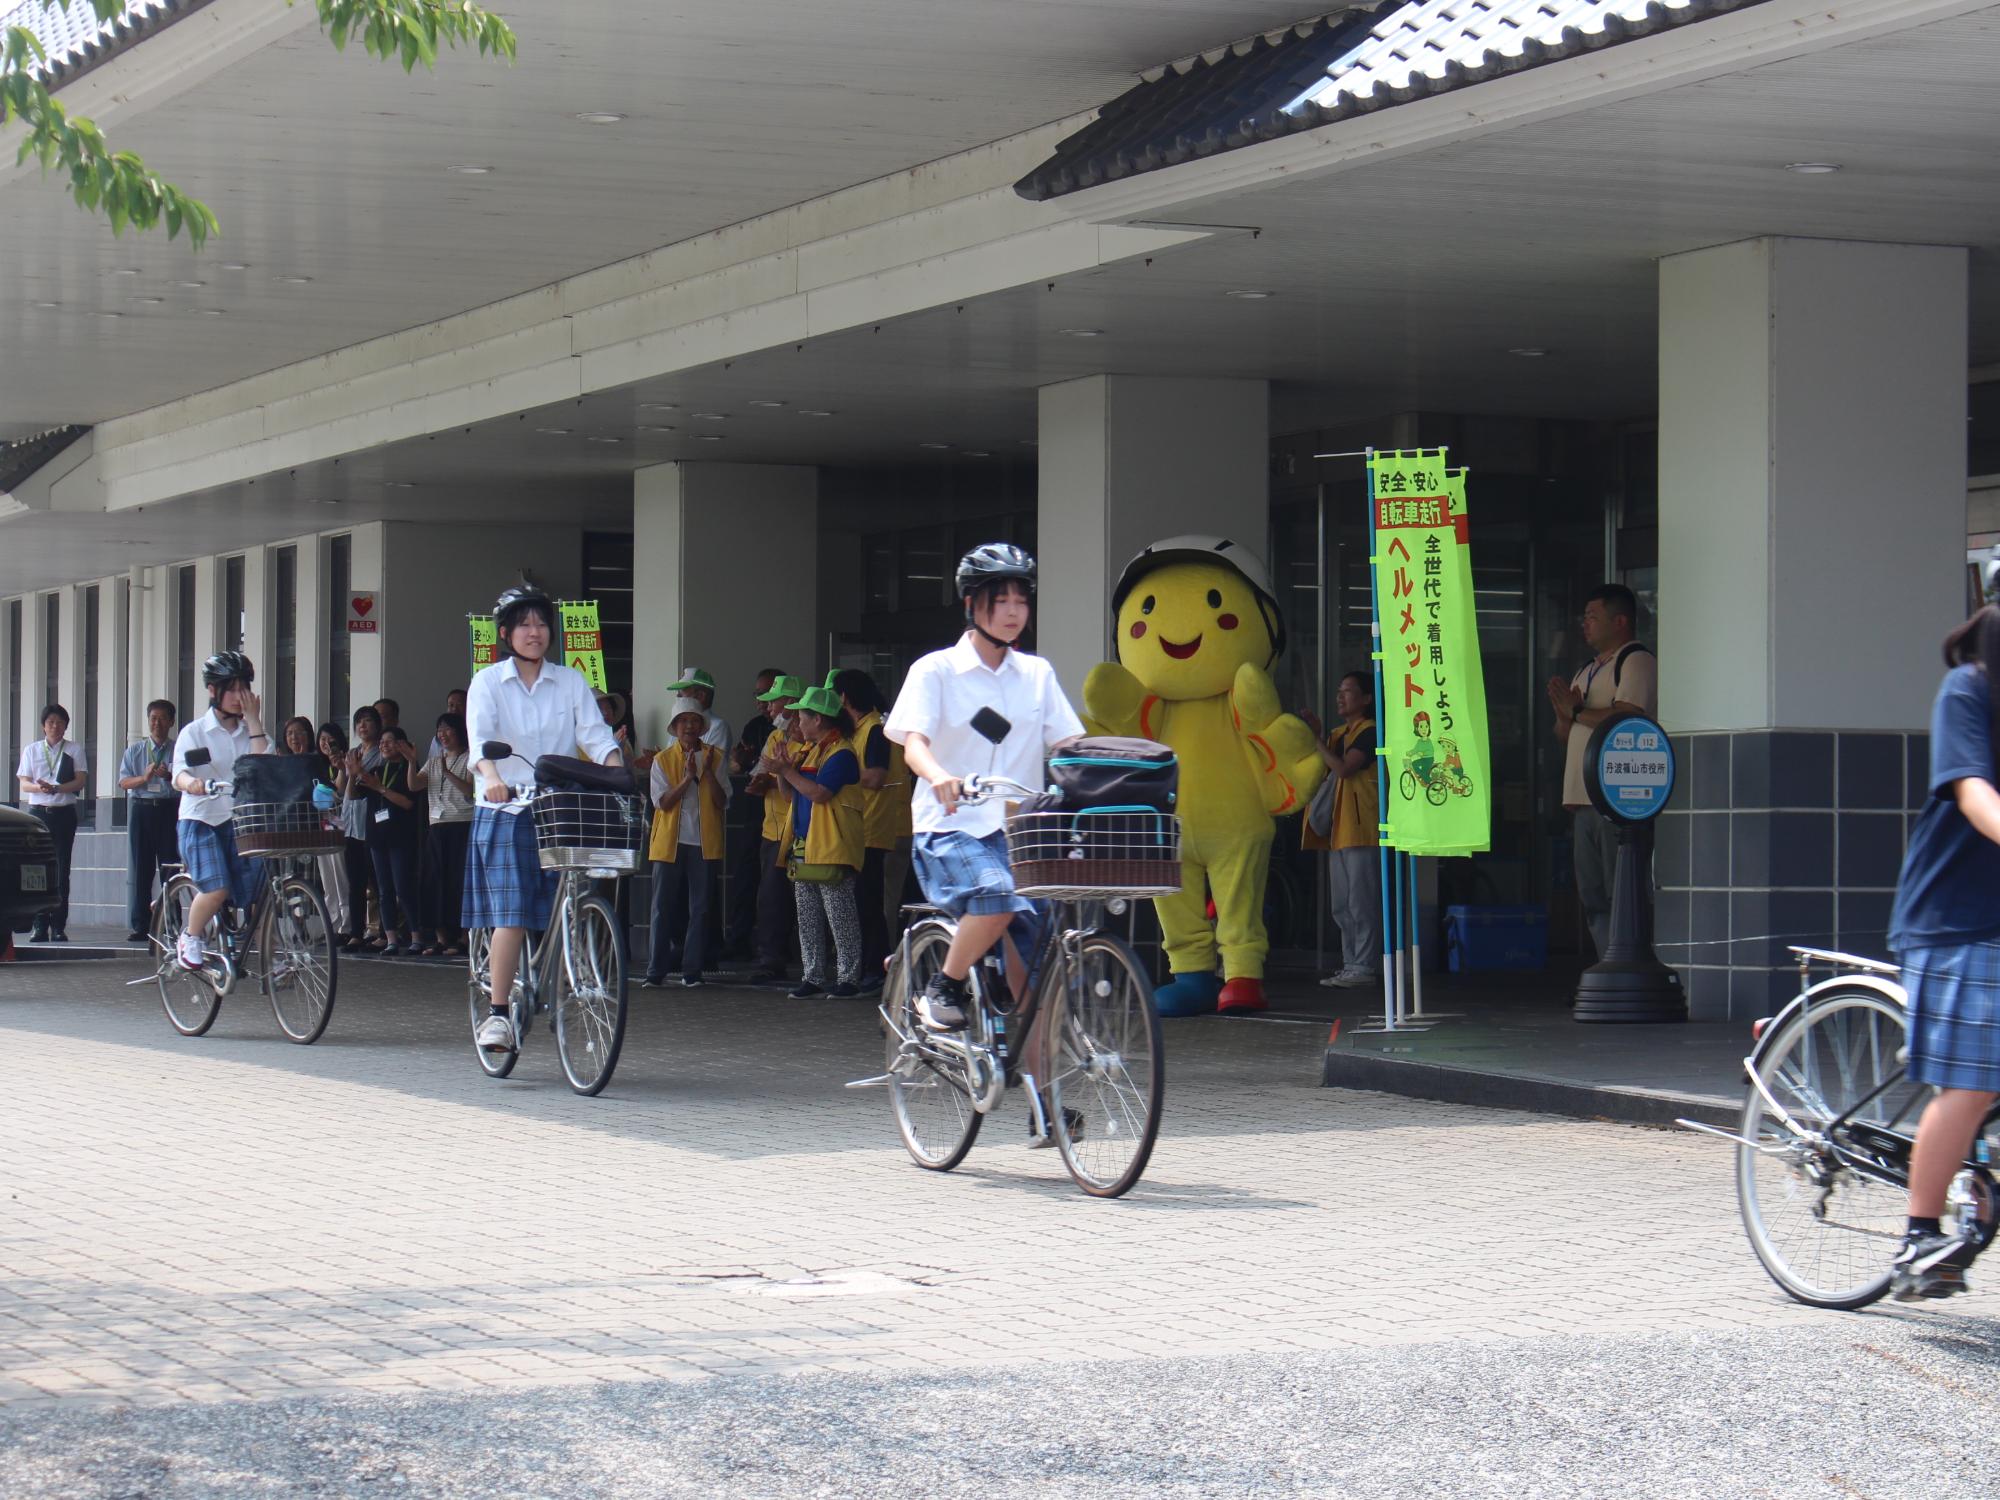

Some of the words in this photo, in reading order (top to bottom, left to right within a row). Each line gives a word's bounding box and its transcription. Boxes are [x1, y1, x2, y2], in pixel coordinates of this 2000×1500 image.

[1381, 501, 1442, 526] 自転車走行
[1388, 537, 1424, 707] ヘルメット
[1424, 534, 1453, 730] 全世代で着用しよう
[1642, 738, 1655, 747] 112
[1606, 762, 1665, 774] 丹波篠山市役所
